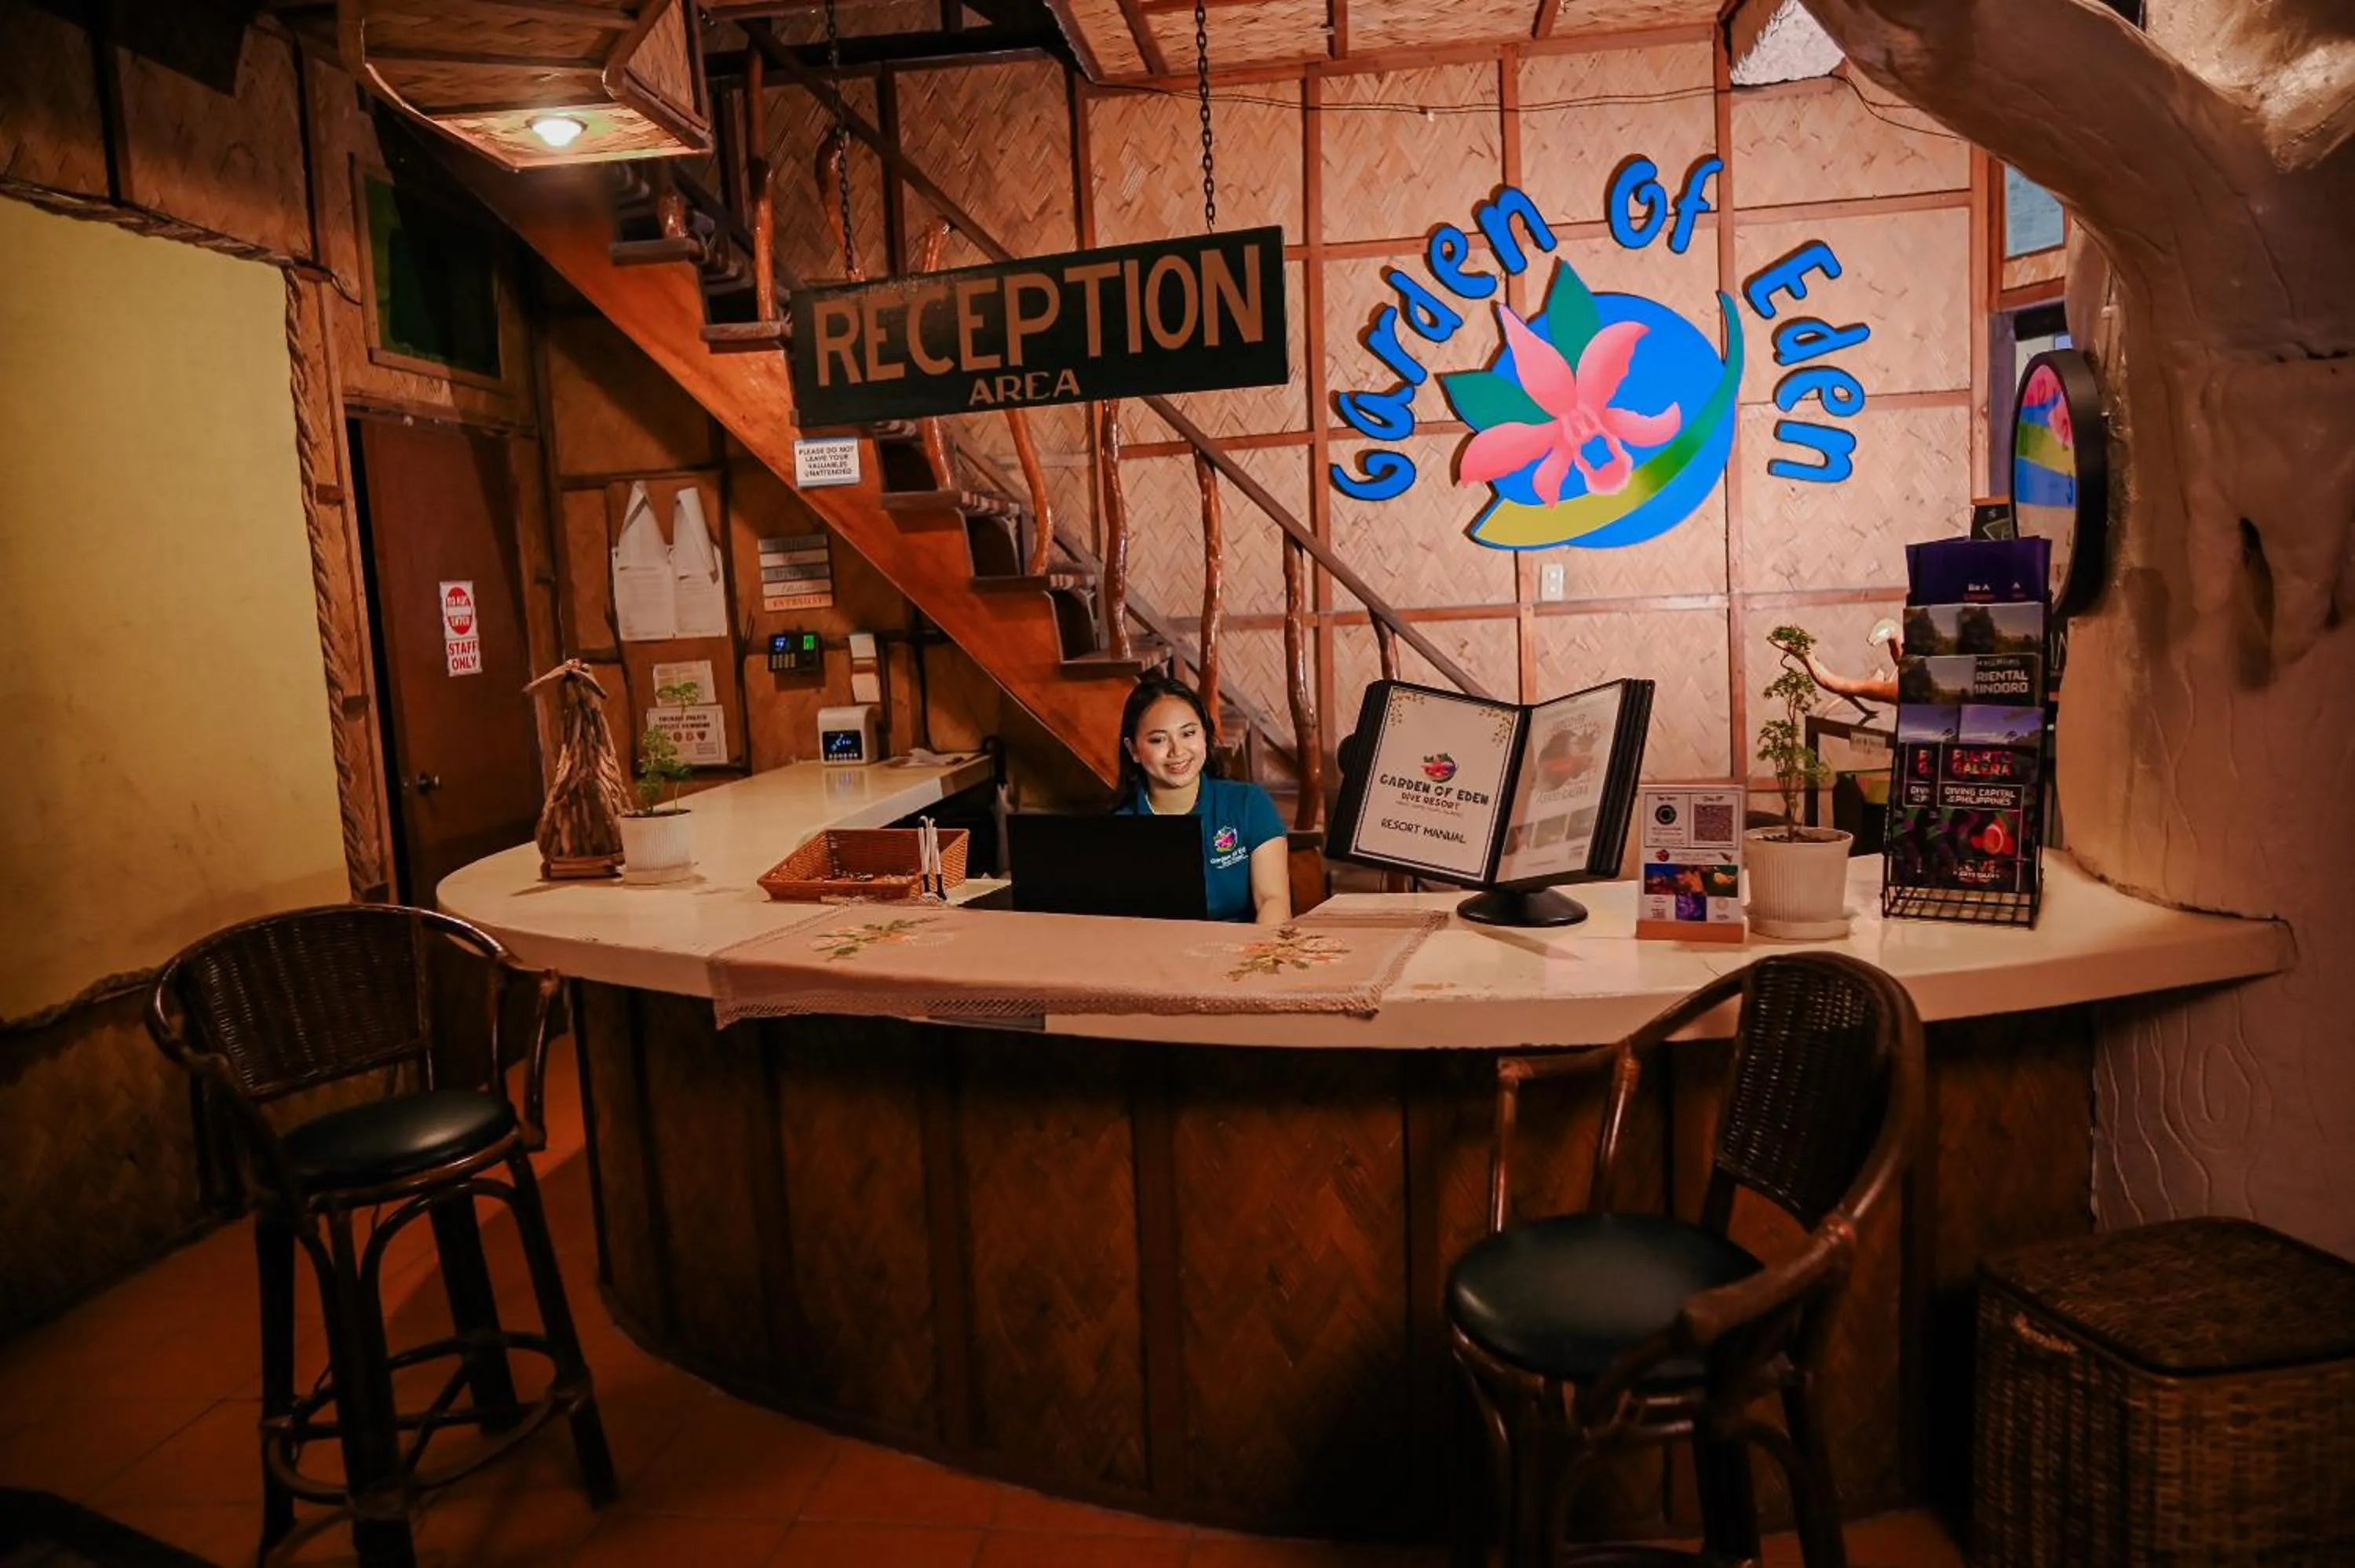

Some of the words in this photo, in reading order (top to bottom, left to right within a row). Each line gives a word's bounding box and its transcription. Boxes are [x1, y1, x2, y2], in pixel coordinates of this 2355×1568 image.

[813, 244, 1265, 388] RECEPTION
[1330, 185, 1558, 501] Garden
[1743, 239, 1871, 484] Eden
[968, 367, 1082, 407] AREA
[808, 461, 848, 469] VALUABLES
[804, 468, 853, 478] UNATTENDED
[448, 640, 476, 655] STAFF
[451, 655, 476, 670] ONLY
[1975, 670, 2028, 683] RIENTAL
[1379, 773, 1431, 793] GARDEN
[1434, 786, 1453, 798] OF
[1456, 789, 1489, 805] EDEN
[1944, 786, 1977, 797] DIVING
[1979, 788, 2016, 798] CAPITAL
[1401, 792, 1422, 803] DIVE
[1423, 797, 1461, 810] RESORT
[1955, 795, 2012, 806] PHILIPPINES
[1381, 817, 1422, 834] RESORT
[1423, 826, 1467, 844] MANUAL
